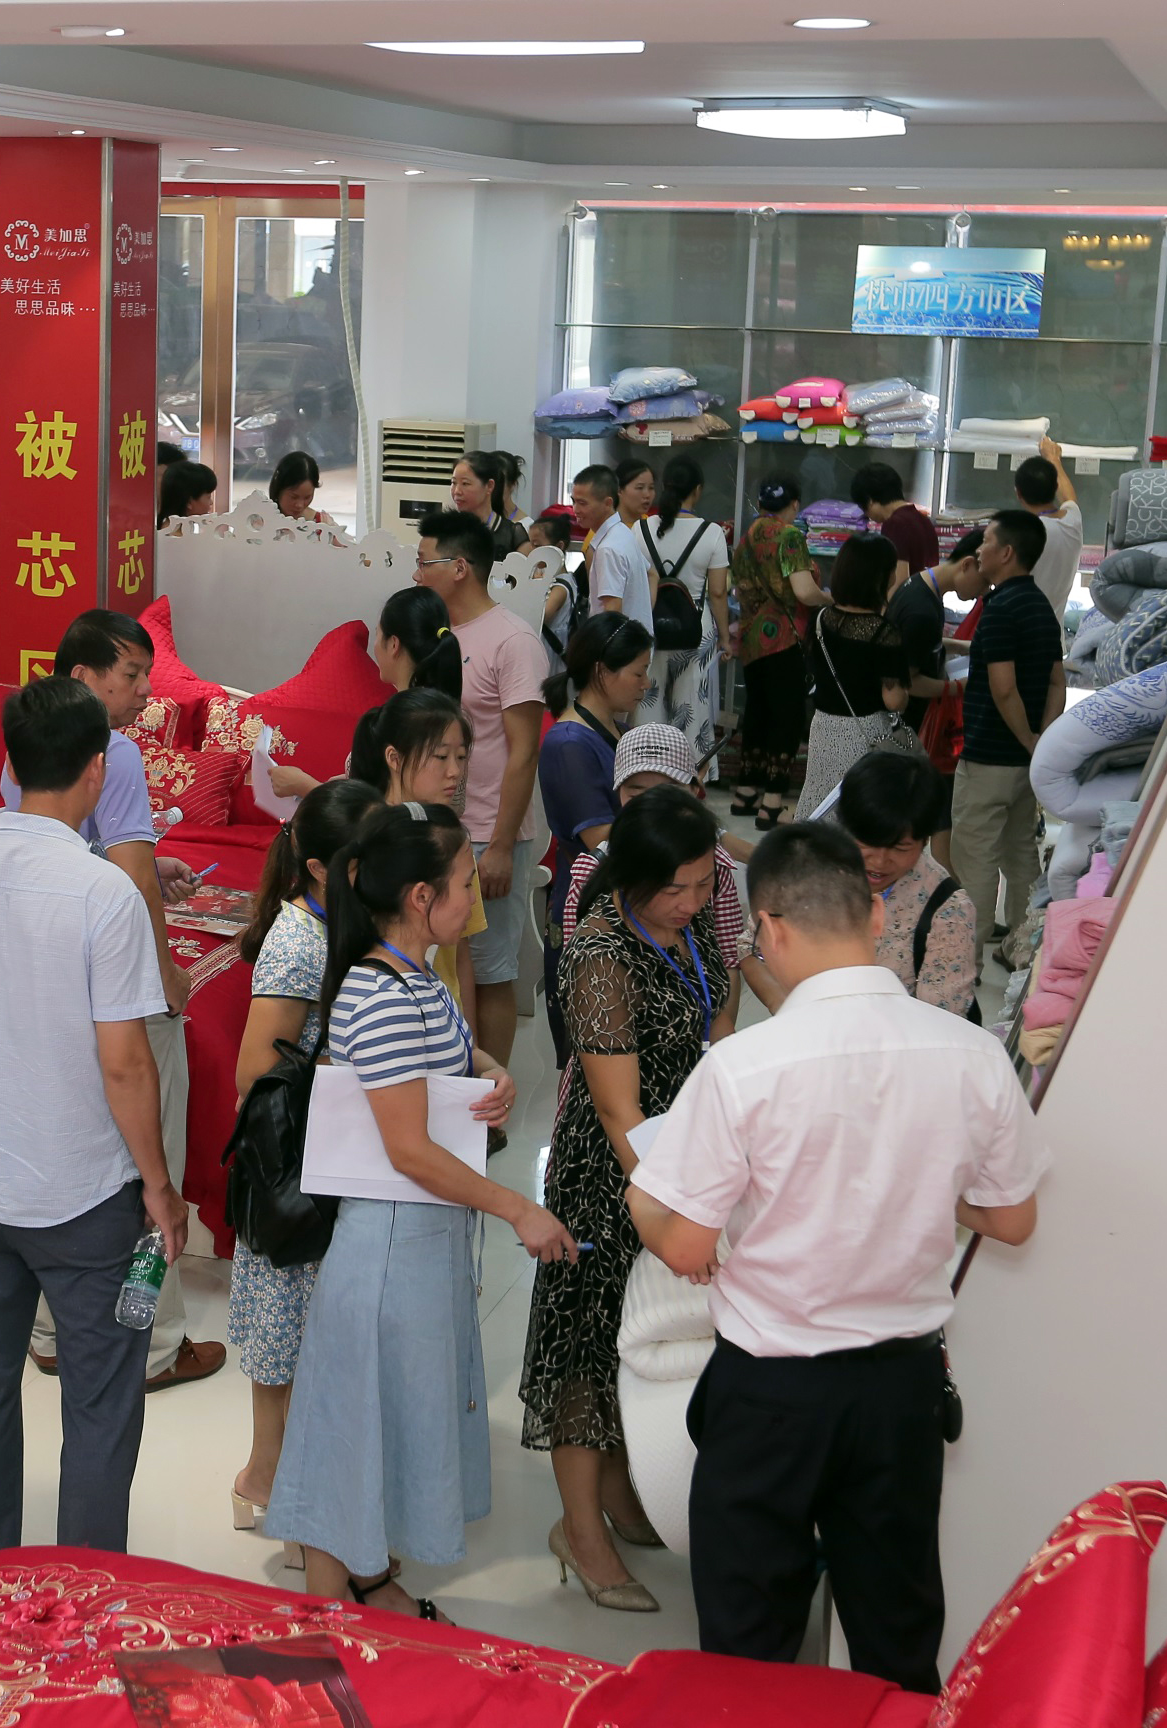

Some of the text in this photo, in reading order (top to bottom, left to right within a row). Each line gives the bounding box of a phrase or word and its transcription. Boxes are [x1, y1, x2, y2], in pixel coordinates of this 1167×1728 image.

[44, 227, 87, 243] 美加思
[0, 277, 61, 295] 美好生活
[113, 281, 142, 297] 美好生活
[117, 410, 147, 595] 被芯
